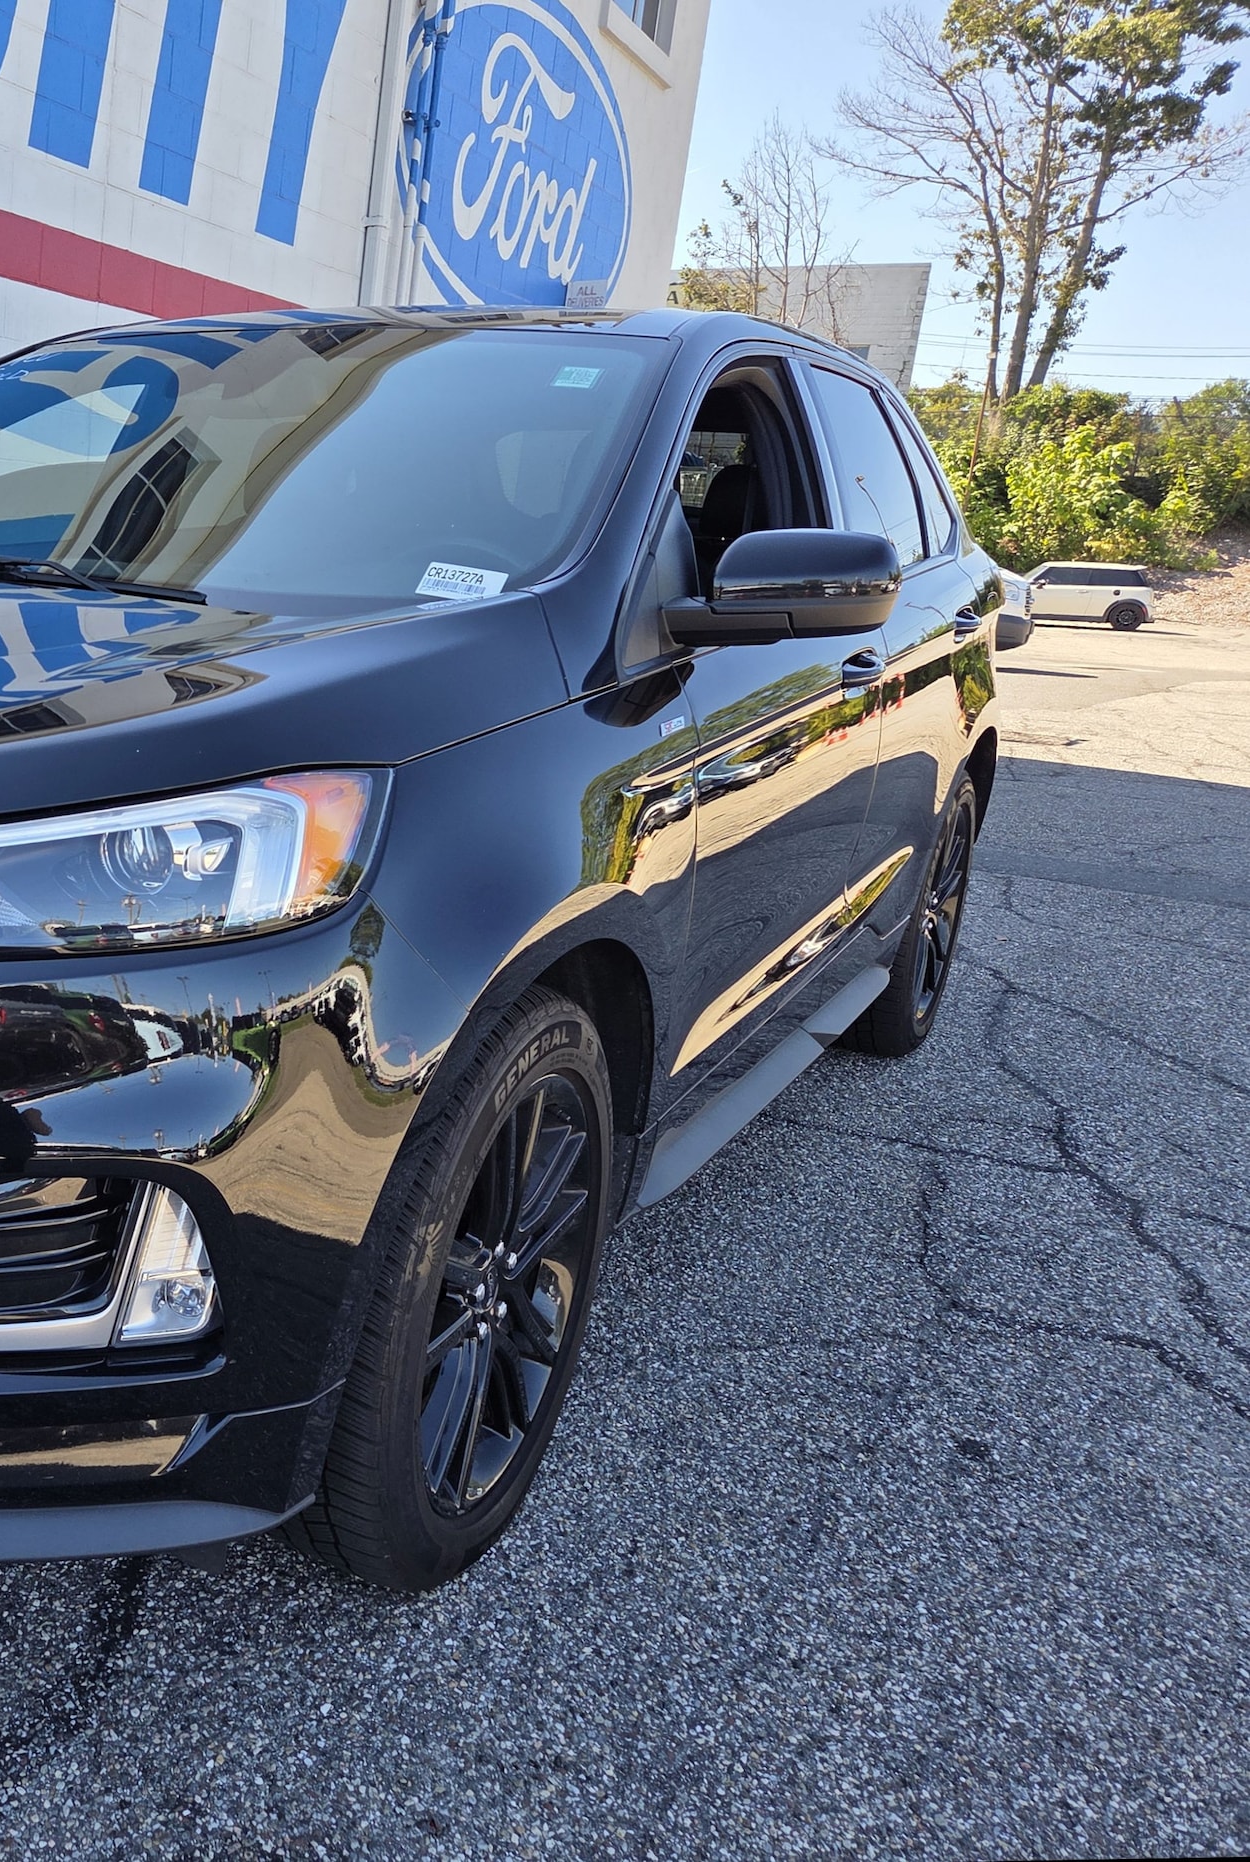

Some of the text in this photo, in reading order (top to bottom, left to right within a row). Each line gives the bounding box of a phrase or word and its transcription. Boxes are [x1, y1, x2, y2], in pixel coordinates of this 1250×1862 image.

[452, 31, 598, 286] Ford
[576, 286, 597, 297] ALL
[427, 567, 484, 585] CR13727A
[494, 1025, 570, 1114] GENERAL
